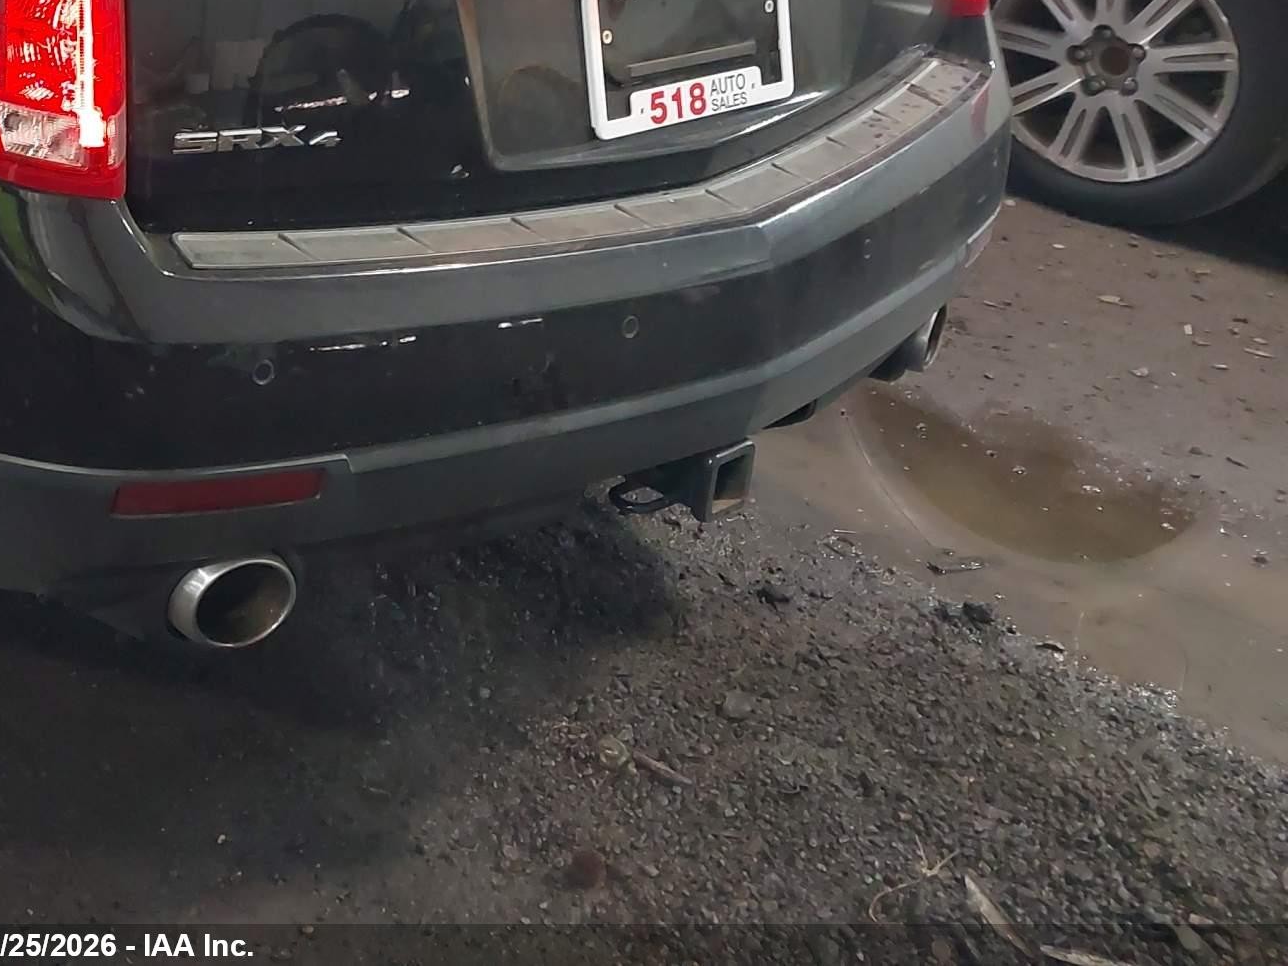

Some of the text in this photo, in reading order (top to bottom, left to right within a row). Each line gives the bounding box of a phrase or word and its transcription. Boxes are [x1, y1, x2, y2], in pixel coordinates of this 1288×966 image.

[650, 73, 746, 124] 518 AUTO
[711, 92, 748, 112] SALES
